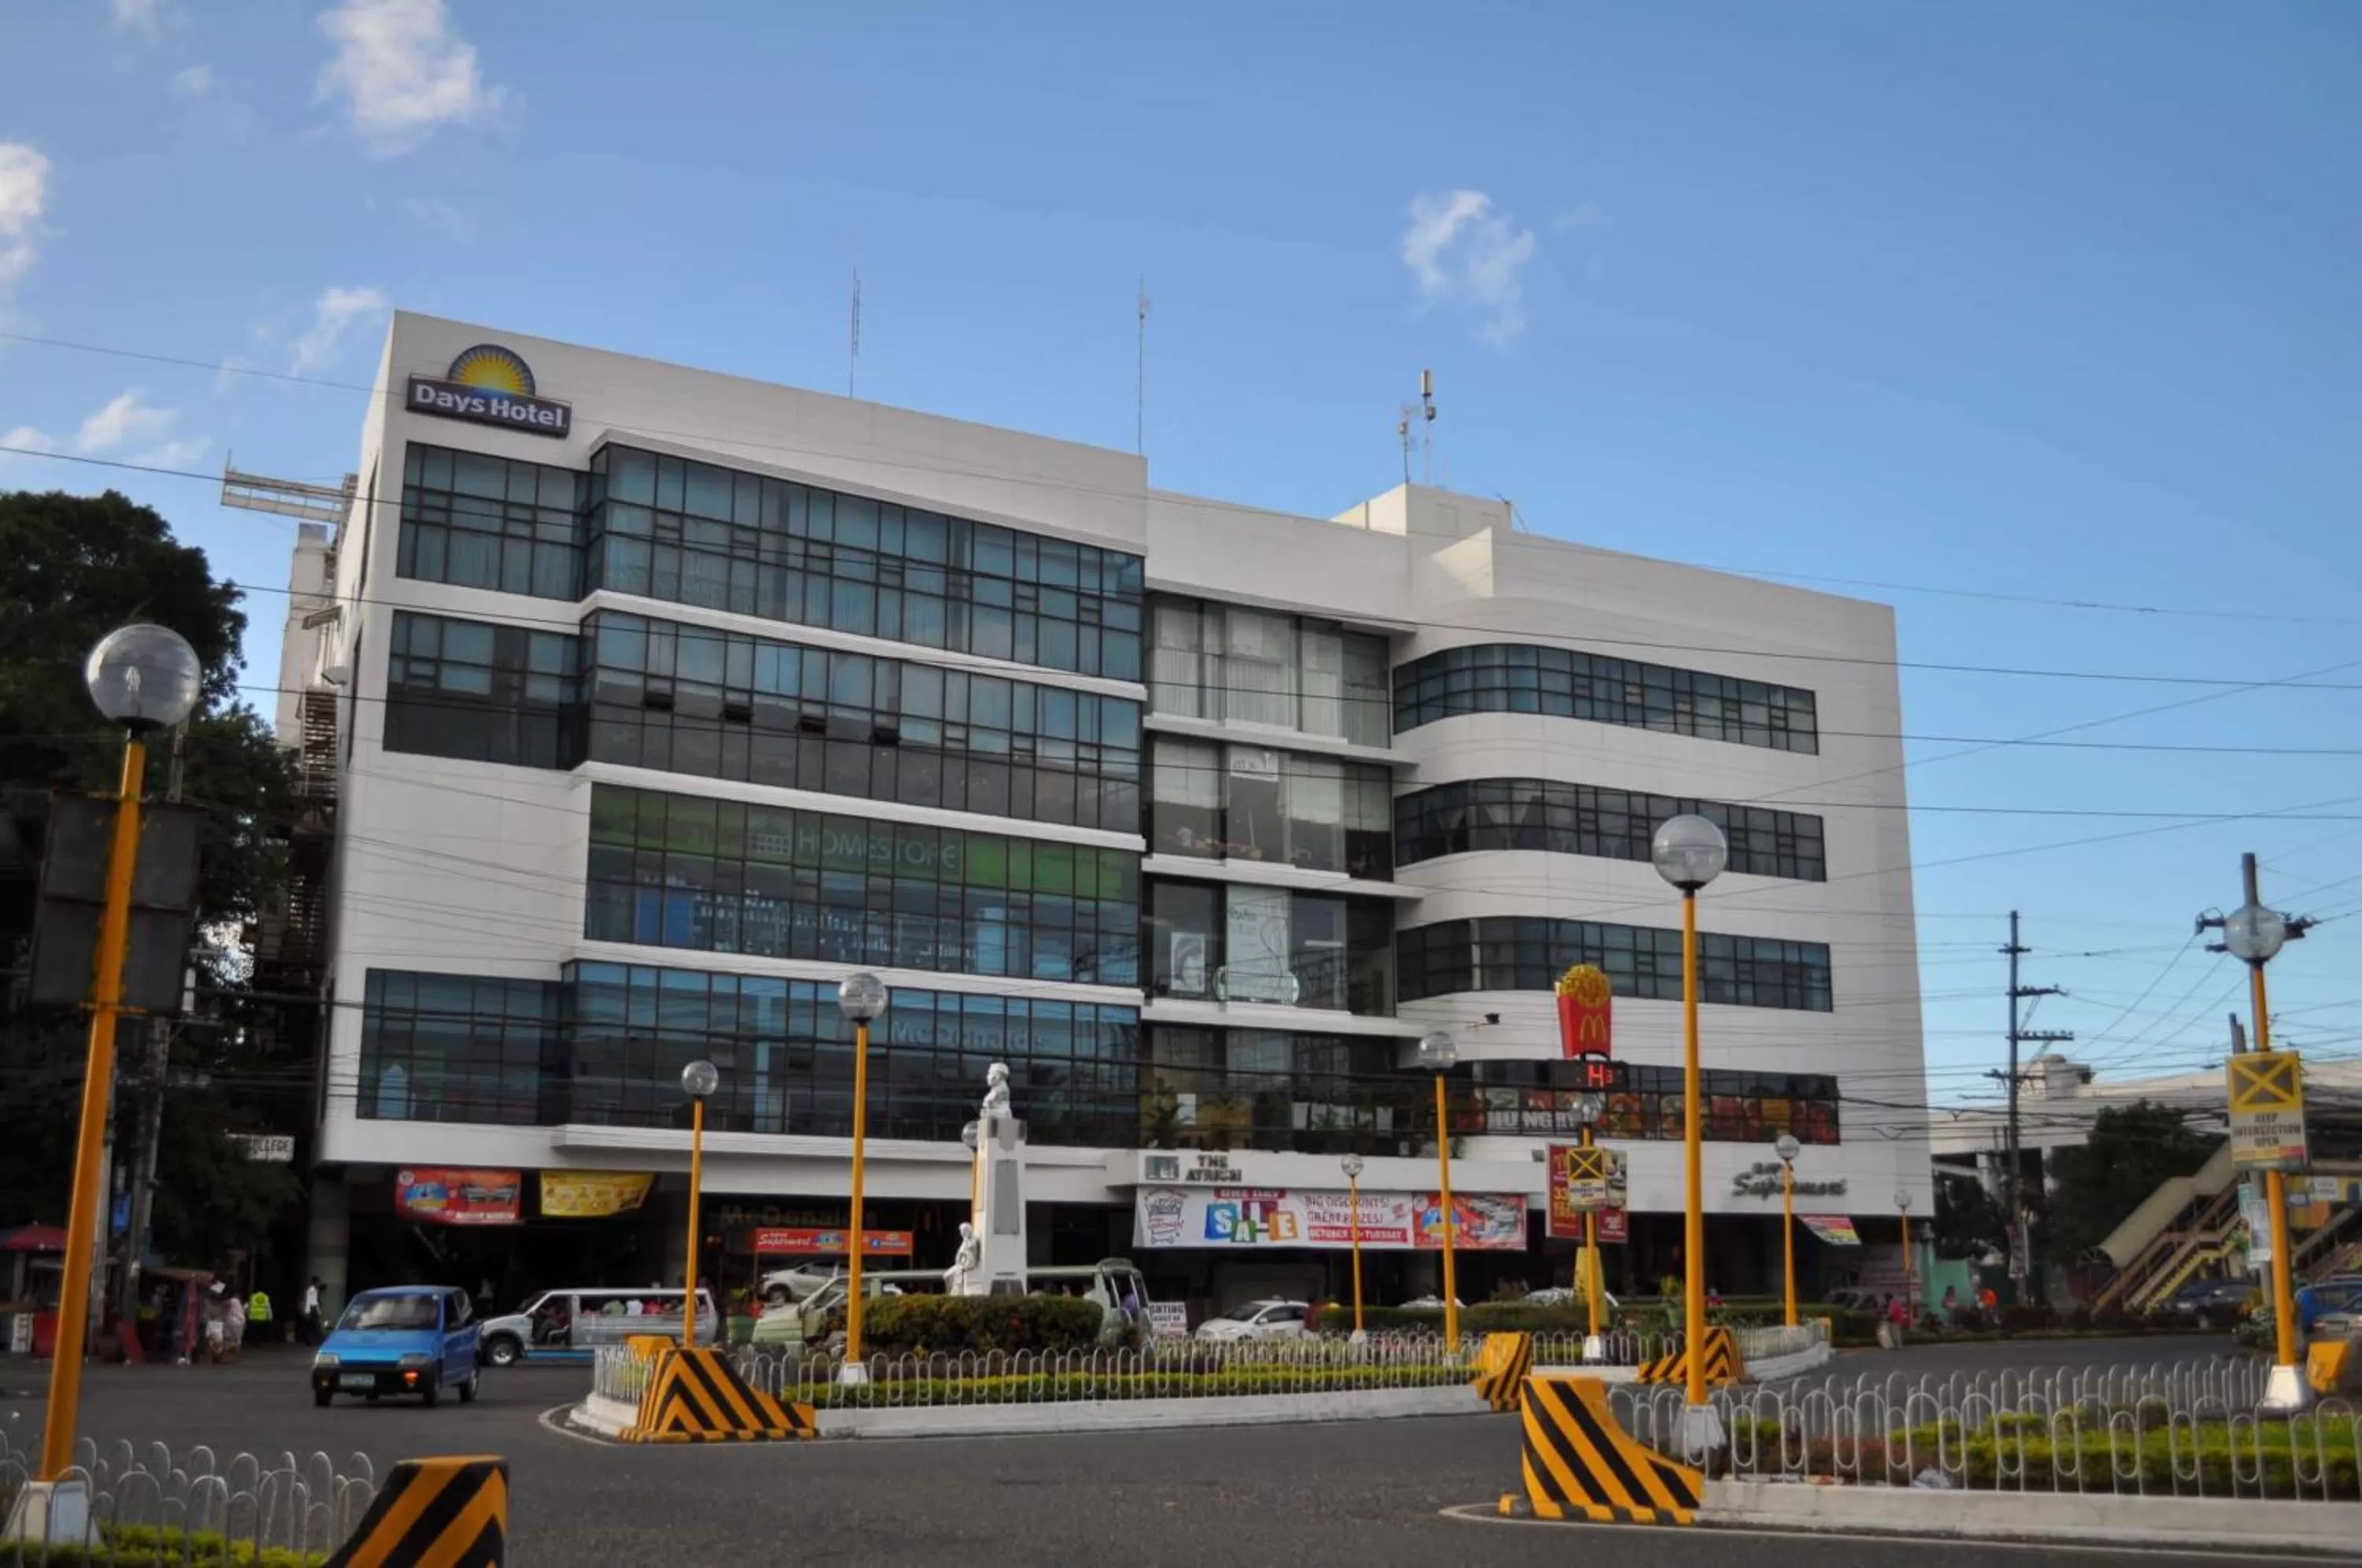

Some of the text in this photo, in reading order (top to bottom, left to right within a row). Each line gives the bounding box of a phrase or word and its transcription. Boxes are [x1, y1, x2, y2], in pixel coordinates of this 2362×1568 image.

[415, 384, 563, 427] Days Hotel
[1197, 1155, 1228, 1167] THE
[1327, 1196, 1390, 1208] DISCUNTS!
[1213, 1202, 1294, 1242] SALE
